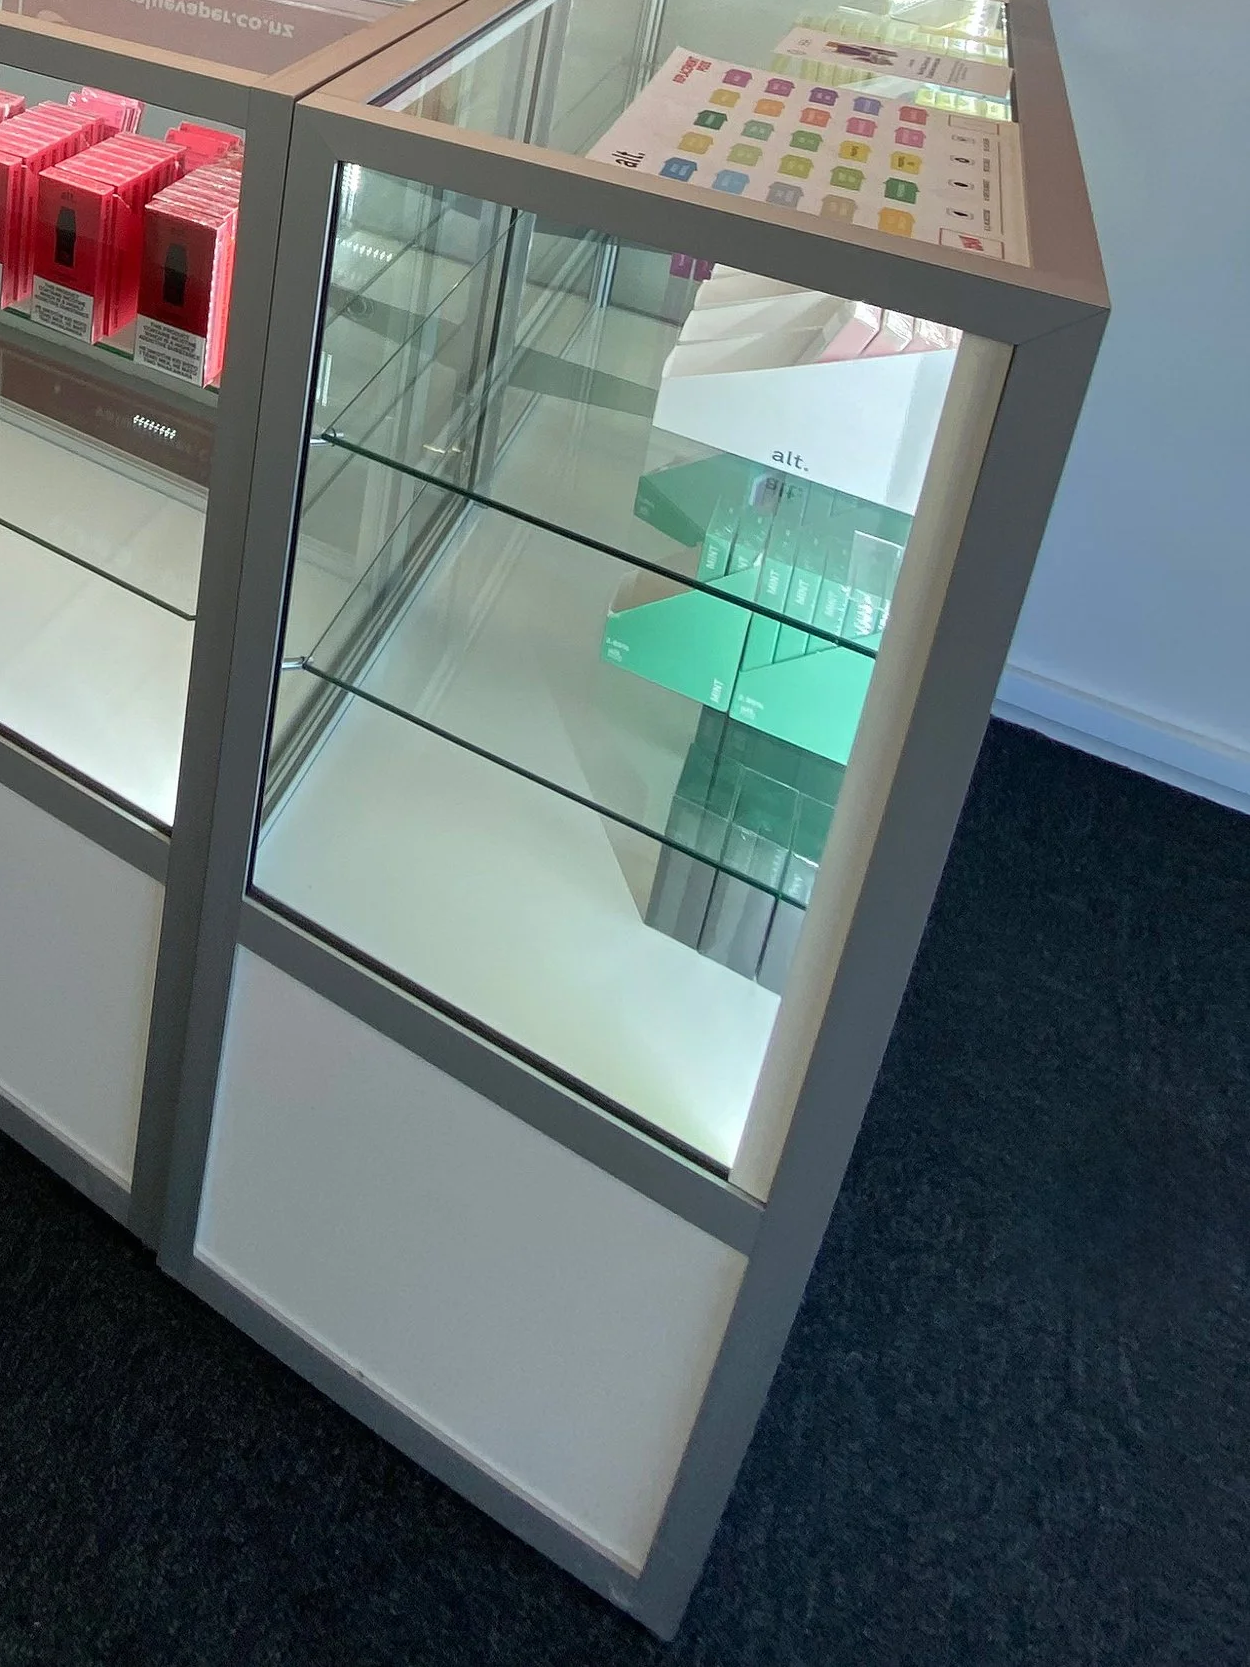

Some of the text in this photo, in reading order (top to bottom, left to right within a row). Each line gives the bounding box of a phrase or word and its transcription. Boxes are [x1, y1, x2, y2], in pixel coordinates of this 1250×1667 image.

[611, 150, 646, 168] alt.
[772, 450, 809, 472] alt.
[706, 546, 719, 570] MINT
[795, 578, 810, 606] MINT
